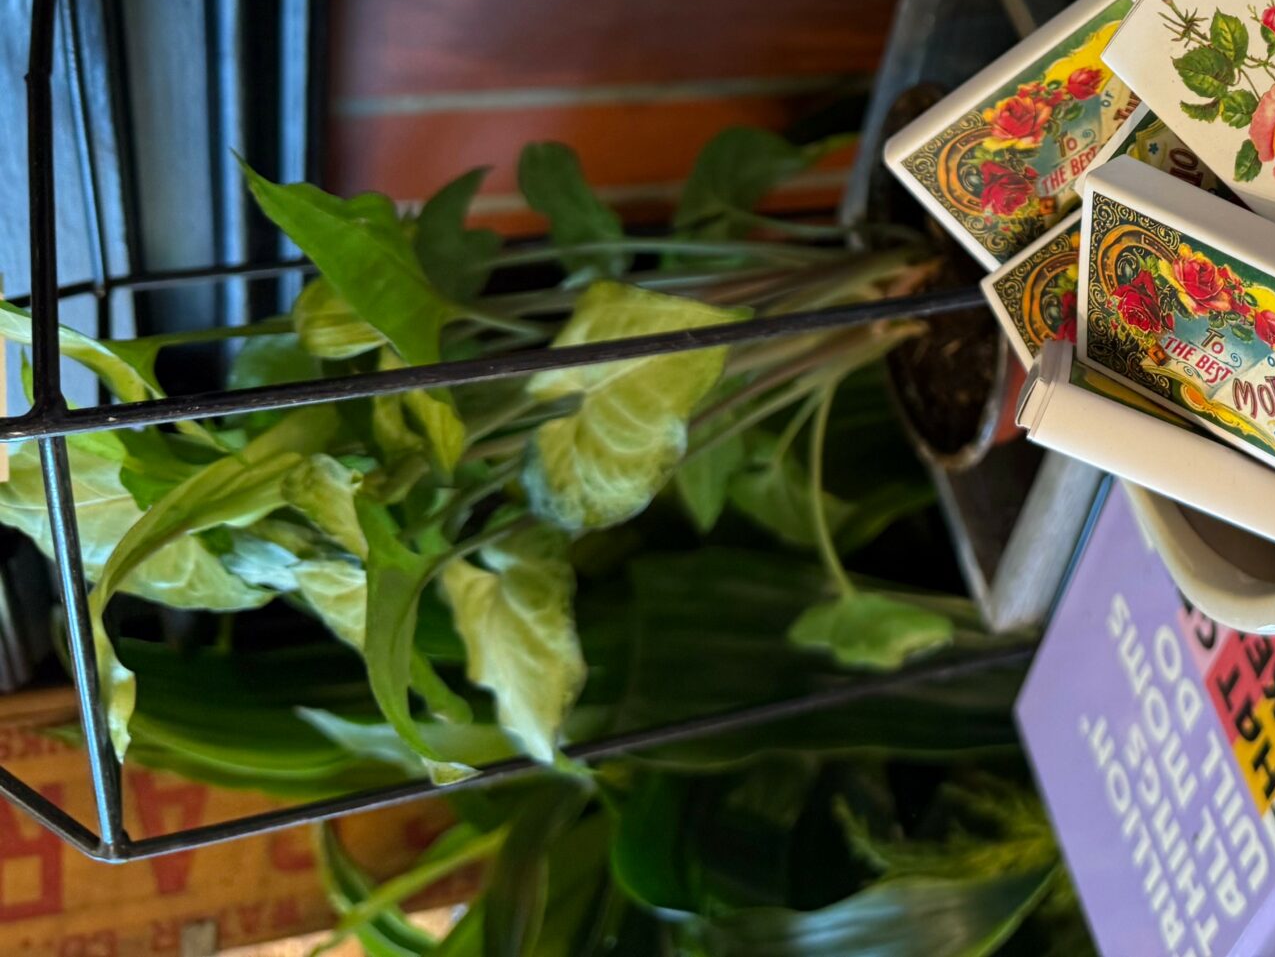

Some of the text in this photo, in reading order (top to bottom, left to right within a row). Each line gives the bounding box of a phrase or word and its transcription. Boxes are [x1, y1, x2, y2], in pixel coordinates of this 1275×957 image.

[1101, 90, 1112, 107] OF
[1042, 146, 1098, 194] THE BEST
[1058, 131, 1078, 157] TO
[1165, 335, 1233, 385] THE BEST
[1201, 328, 1225, 354] TO
[1106, 593, 1197, 808] MOMS
[1154, 625, 1202, 731] DO
[1124, 723, 1219, 957] THINGS
[1201, 729, 1269, 891] WILL
[1194, 806, 1246, 917] ALL
